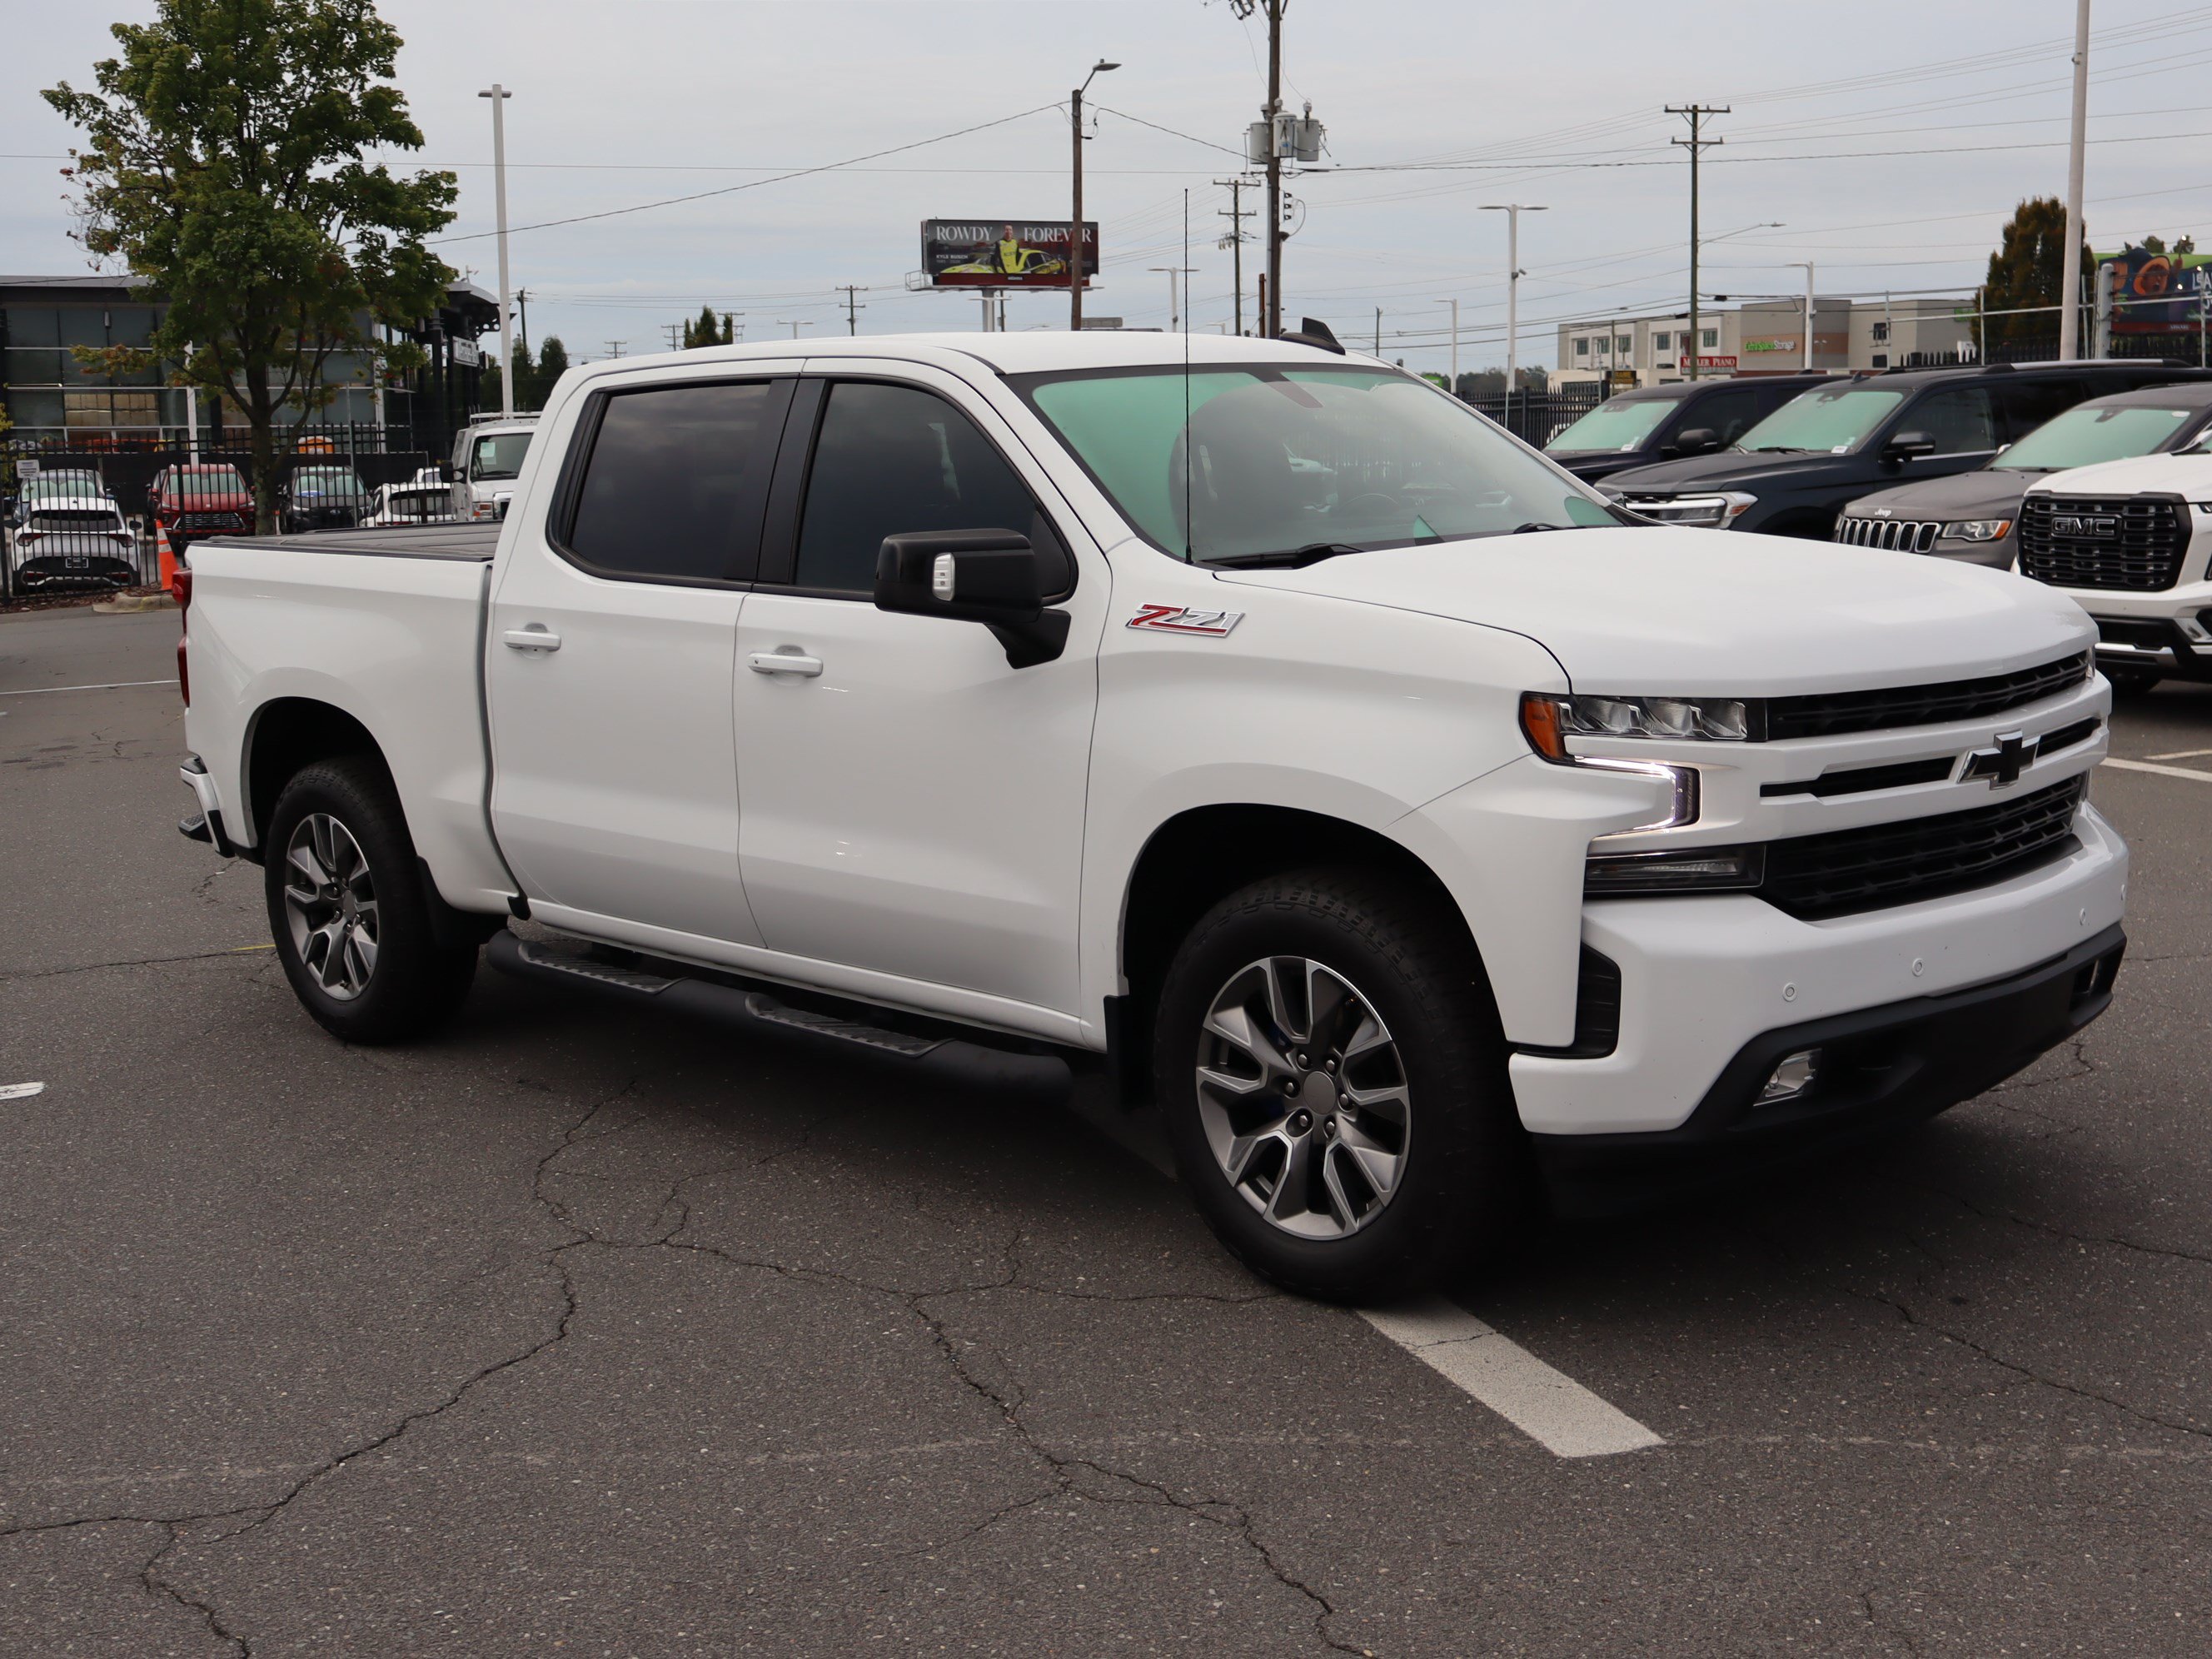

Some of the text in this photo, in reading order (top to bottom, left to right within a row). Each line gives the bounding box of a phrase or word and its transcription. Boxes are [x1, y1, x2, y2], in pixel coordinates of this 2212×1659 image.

[936, 226, 1092, 242] ROWDY FOREVR
[1683, 358, 1736, 366] MLER PIANO
[1874, 507, 1892, 518] Jeep
[2051, 517, 2115, 536] GMC
[1125, 602, 1246, 639] Z71
